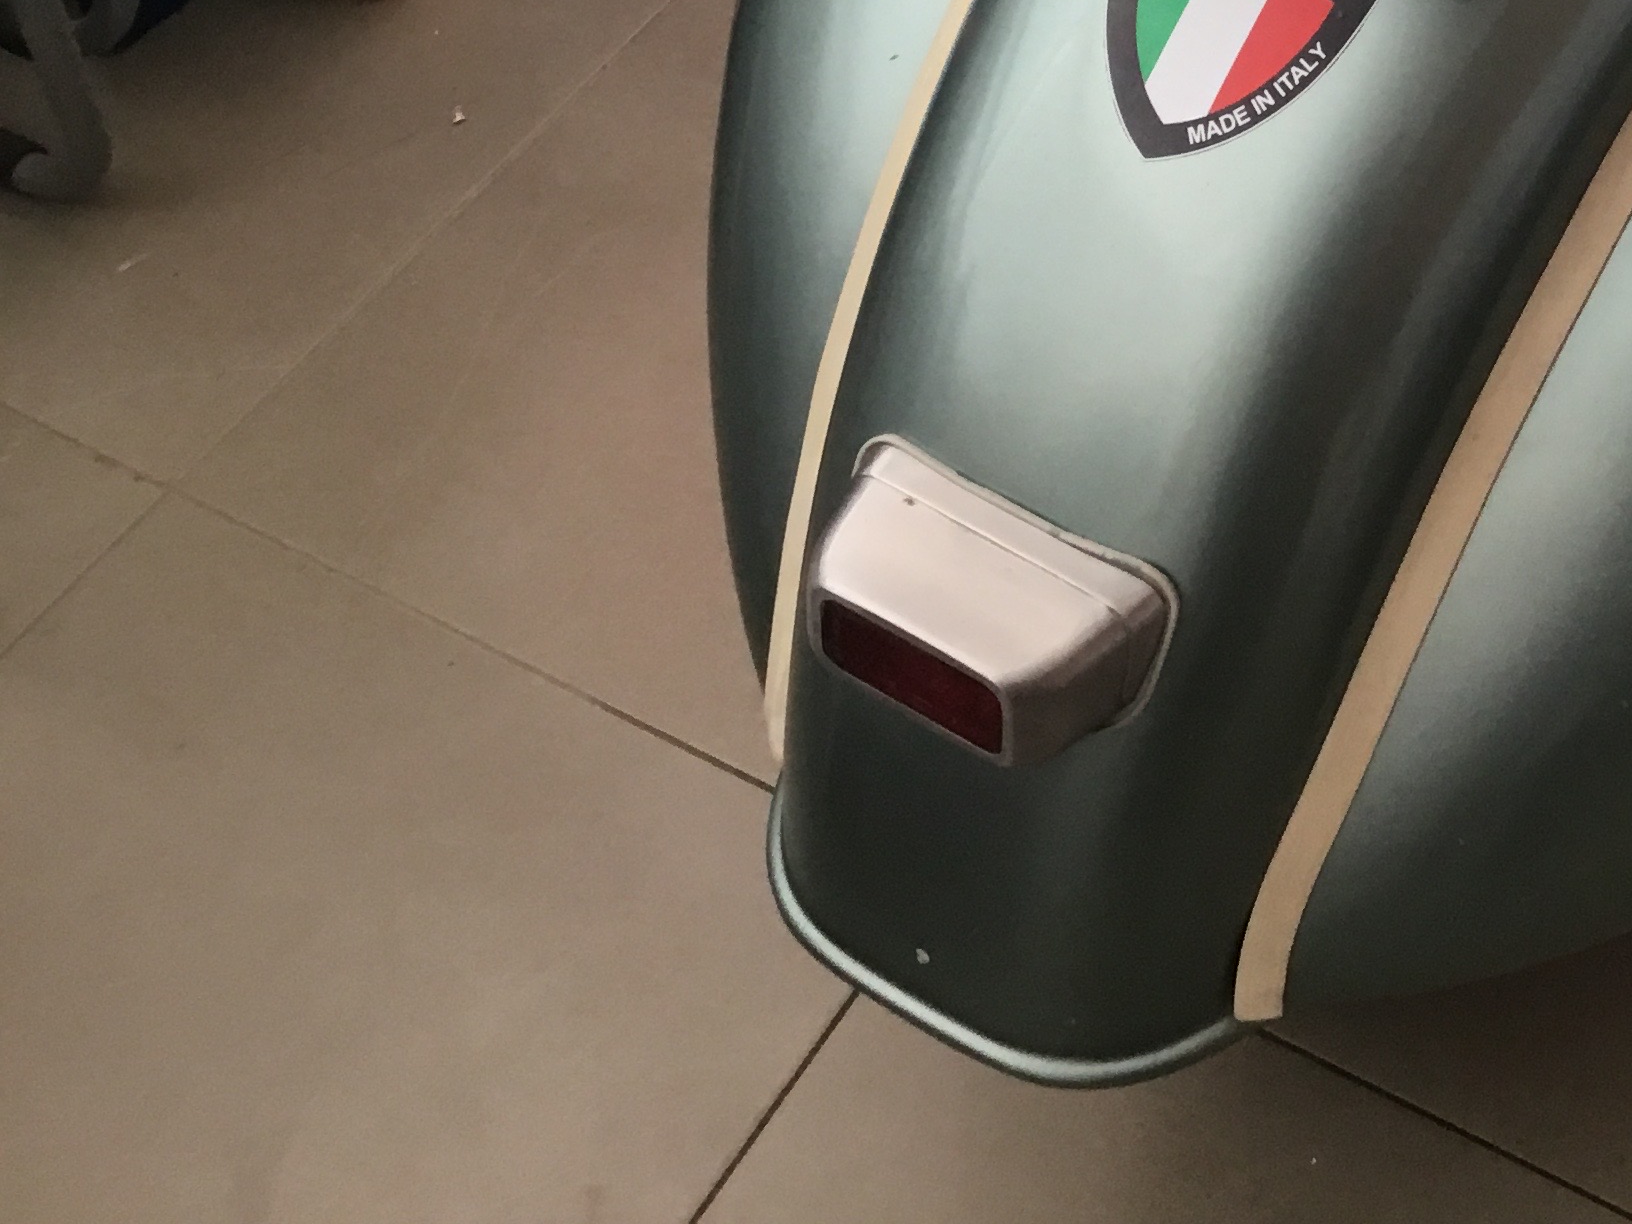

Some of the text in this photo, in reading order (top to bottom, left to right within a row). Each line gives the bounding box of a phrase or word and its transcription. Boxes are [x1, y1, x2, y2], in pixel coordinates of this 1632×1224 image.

[1186, 40, 1327, 145] MADE IN ITALY
